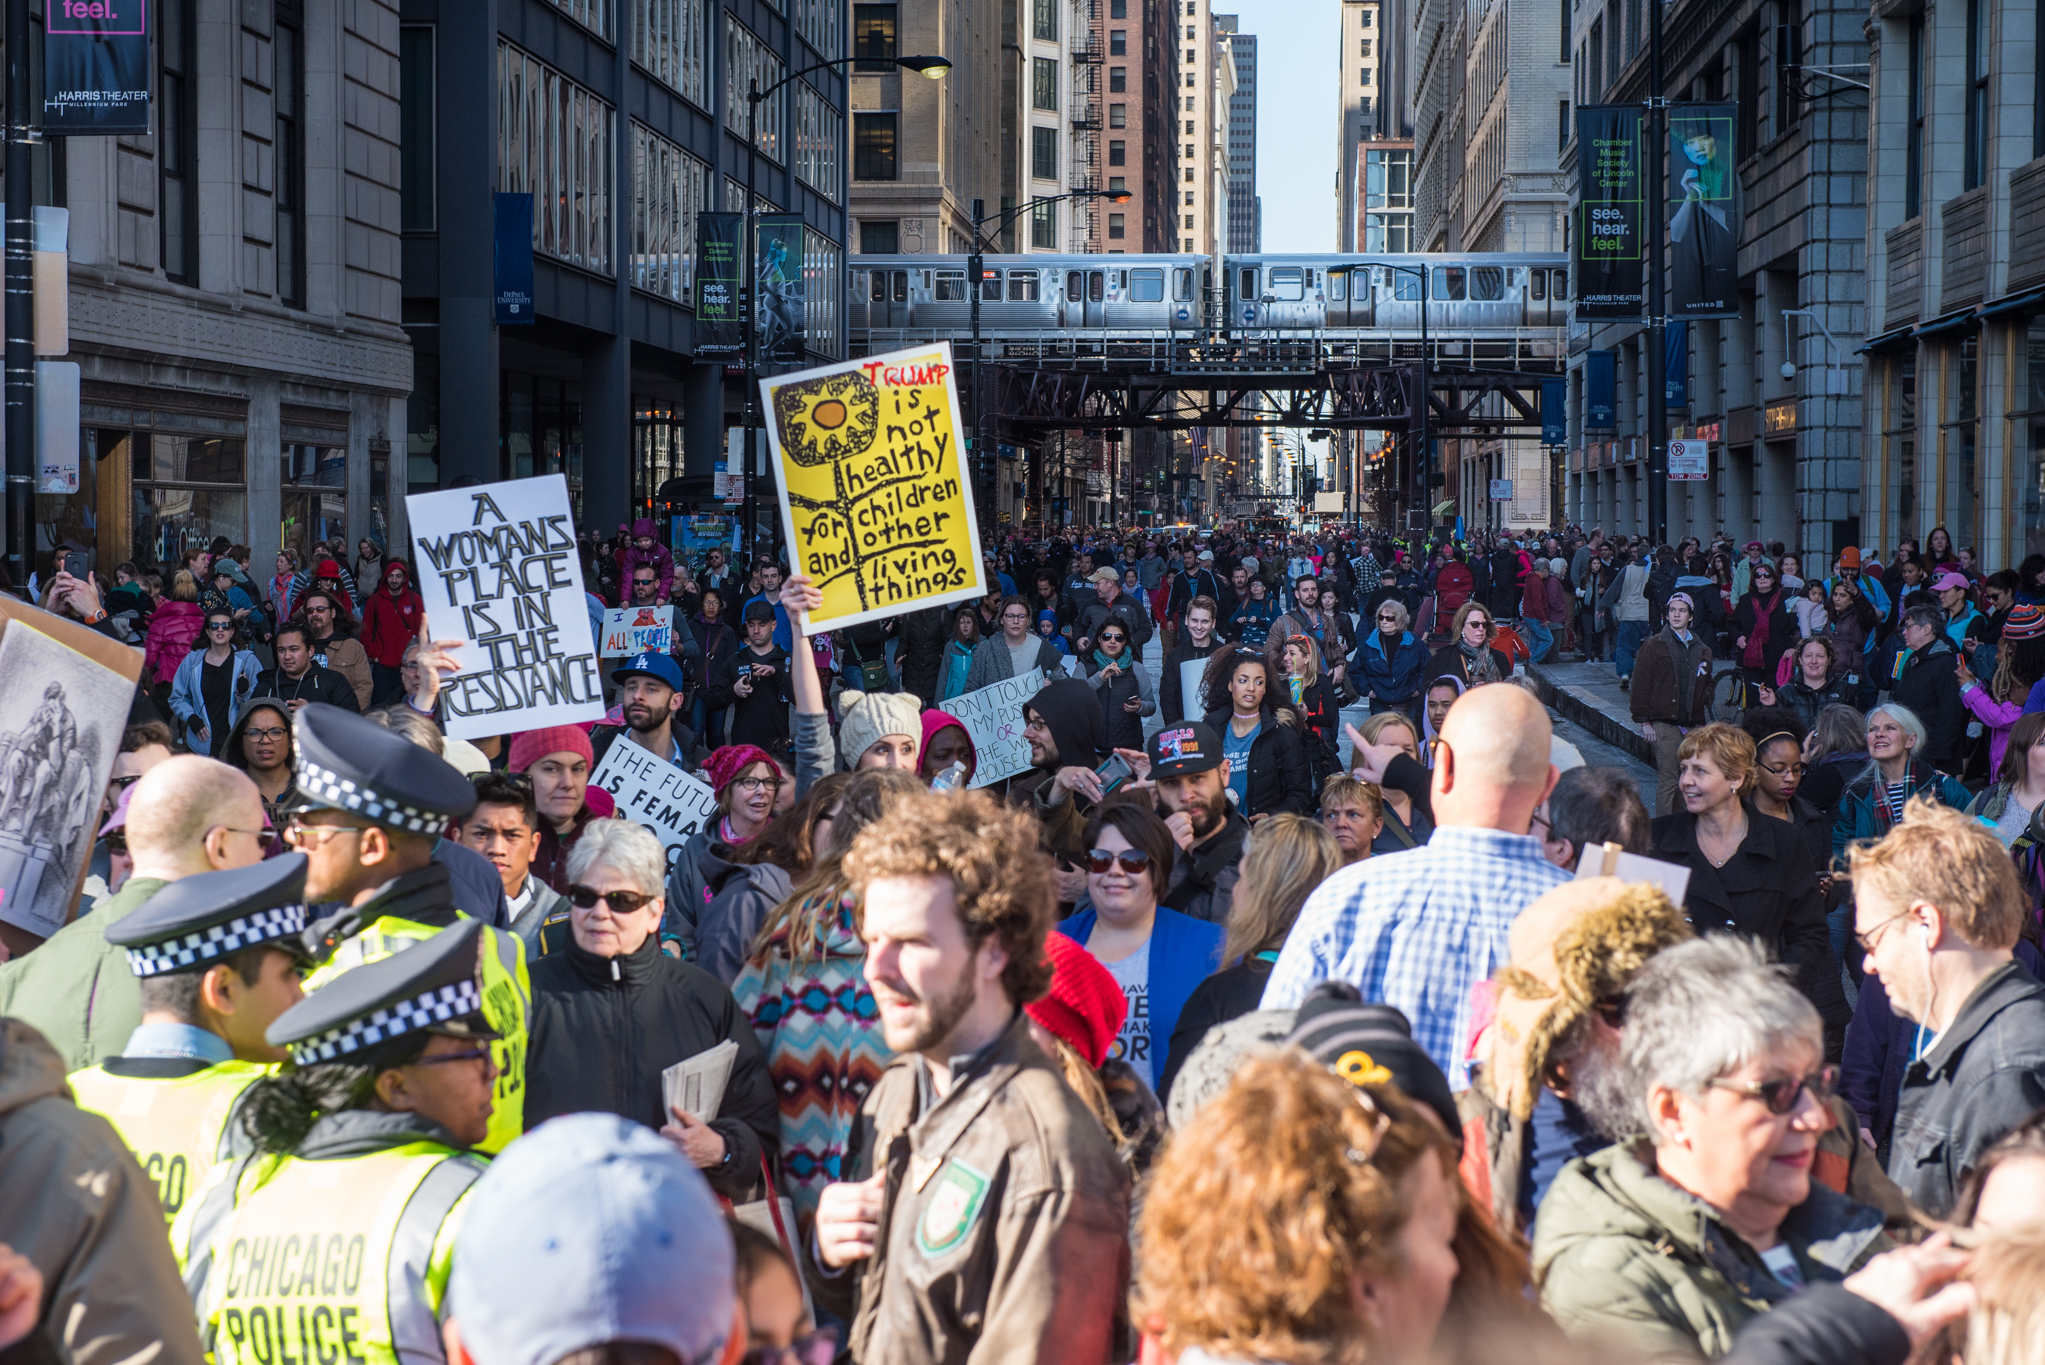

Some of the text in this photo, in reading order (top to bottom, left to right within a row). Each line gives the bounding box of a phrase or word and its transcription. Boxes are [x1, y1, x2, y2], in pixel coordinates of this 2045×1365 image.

[63, 0, 117, 19] feel.
[59, 91, 147, 100] HARRIS THEATER
[1592, 139, 1633, 147] Chamber
[1600, 149, 1626, 157] Music
[1597, 159, 1629, 168] Society
[1592, 208, 1624, 220] see.
[1592, 221, 1630, 235] hear.
[1592, 236, 1624, 250] feel.
[497, 296, 531, 304] UNIVERSITY
[704, 284, 727, 293] see.
[704, 293, 731, 304] hear.
[703, 304, 727, 315] feel.
[863, 361, 949, 387] TRUMP
[893, 389, 922, 415] is
[887, 405, 940, 443] not
[846, 432, 948, 494] healthy
[472, 492, 508, 527] A
[801, 478, 958, 546] for children
[808, 511, 950, 576] and other
[873, 548, 957, 580] living
[440, 553, 573, 607] PLACE
[868, 567, 967, 604] things
[462, 591, 552, 640] IS IN
[614, 613, 624, 622] I
[478, 625, 565, 667] THE
[607, 627, 669, 650] ALL PEOPLE
[635, 654, 648, 669] LA
[439, 653, 603, 722] RESISTANCE
[944, 675, 1044, 718] DON'T TOUCH
[973, 702, 1027, 734] MY PUSS
[997, 724, 1017, 740] OR
[1159, 728, 1195, 742] BULLS
[976, 741, 1004, 764] THE
[1182, 741, 1199, 753] 1991
[975, 753, 1025, 784] HOUSE
[1230, 763, 1248, 773] AME
[613, 744, 717, 817] THE FUTU
[596, 768, 625, 795] IS
[630, 788, 698, 837] FEMA
[227, 1234, 365, 1299] CHICAGO
[226, 1306, 366, 1365] POLICE
